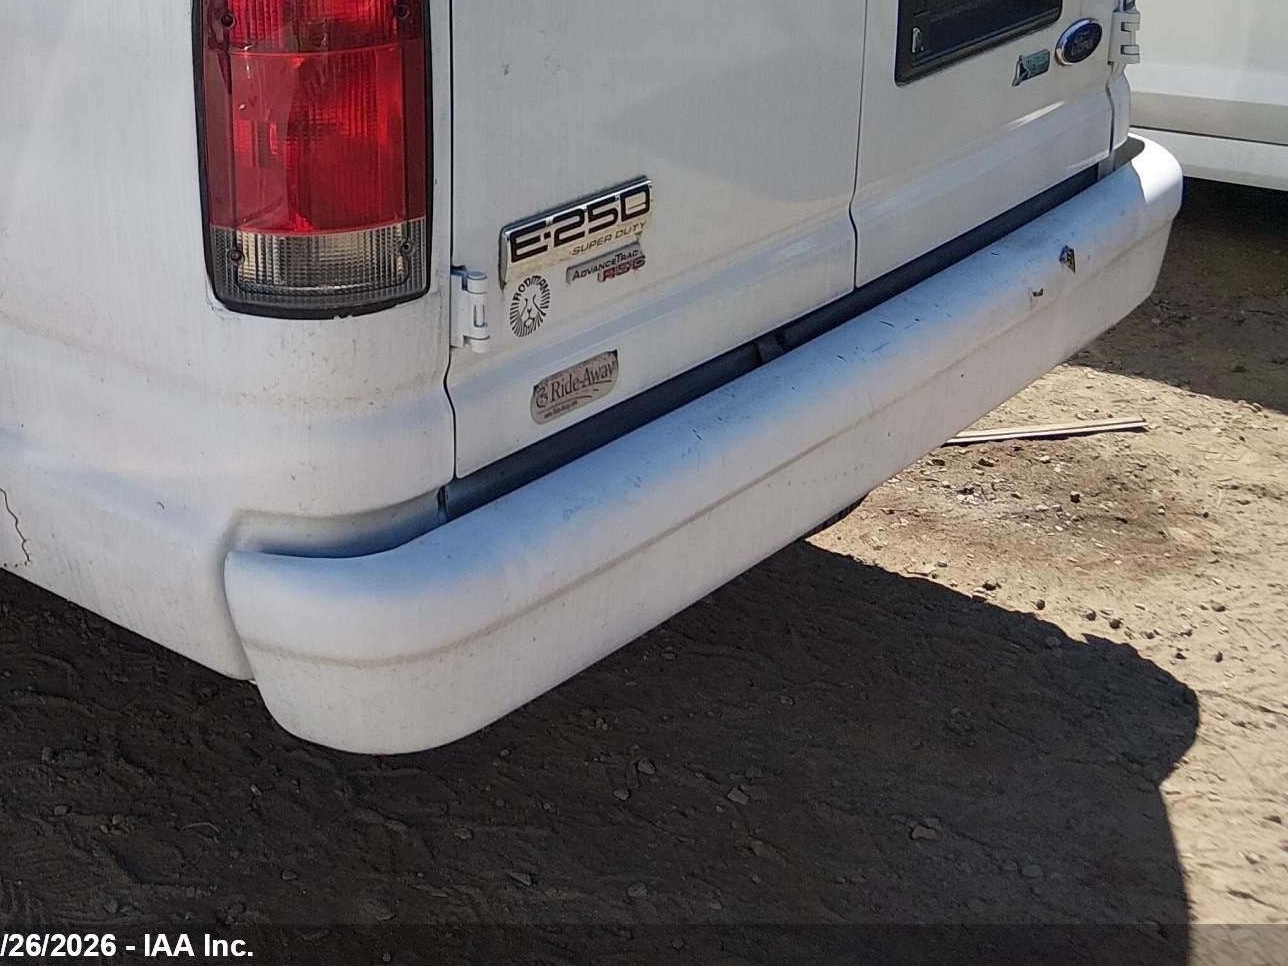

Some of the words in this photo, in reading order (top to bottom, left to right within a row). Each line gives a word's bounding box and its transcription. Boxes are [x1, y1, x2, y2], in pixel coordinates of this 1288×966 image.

[509, 184, 650, 263] E-250
[571, 234, 612, 256] SUPER
[615, 220, 647, 239] DUTY
[602, 253, 646, 282] RSC
[550, 361, 615, 403] Ride-Away
